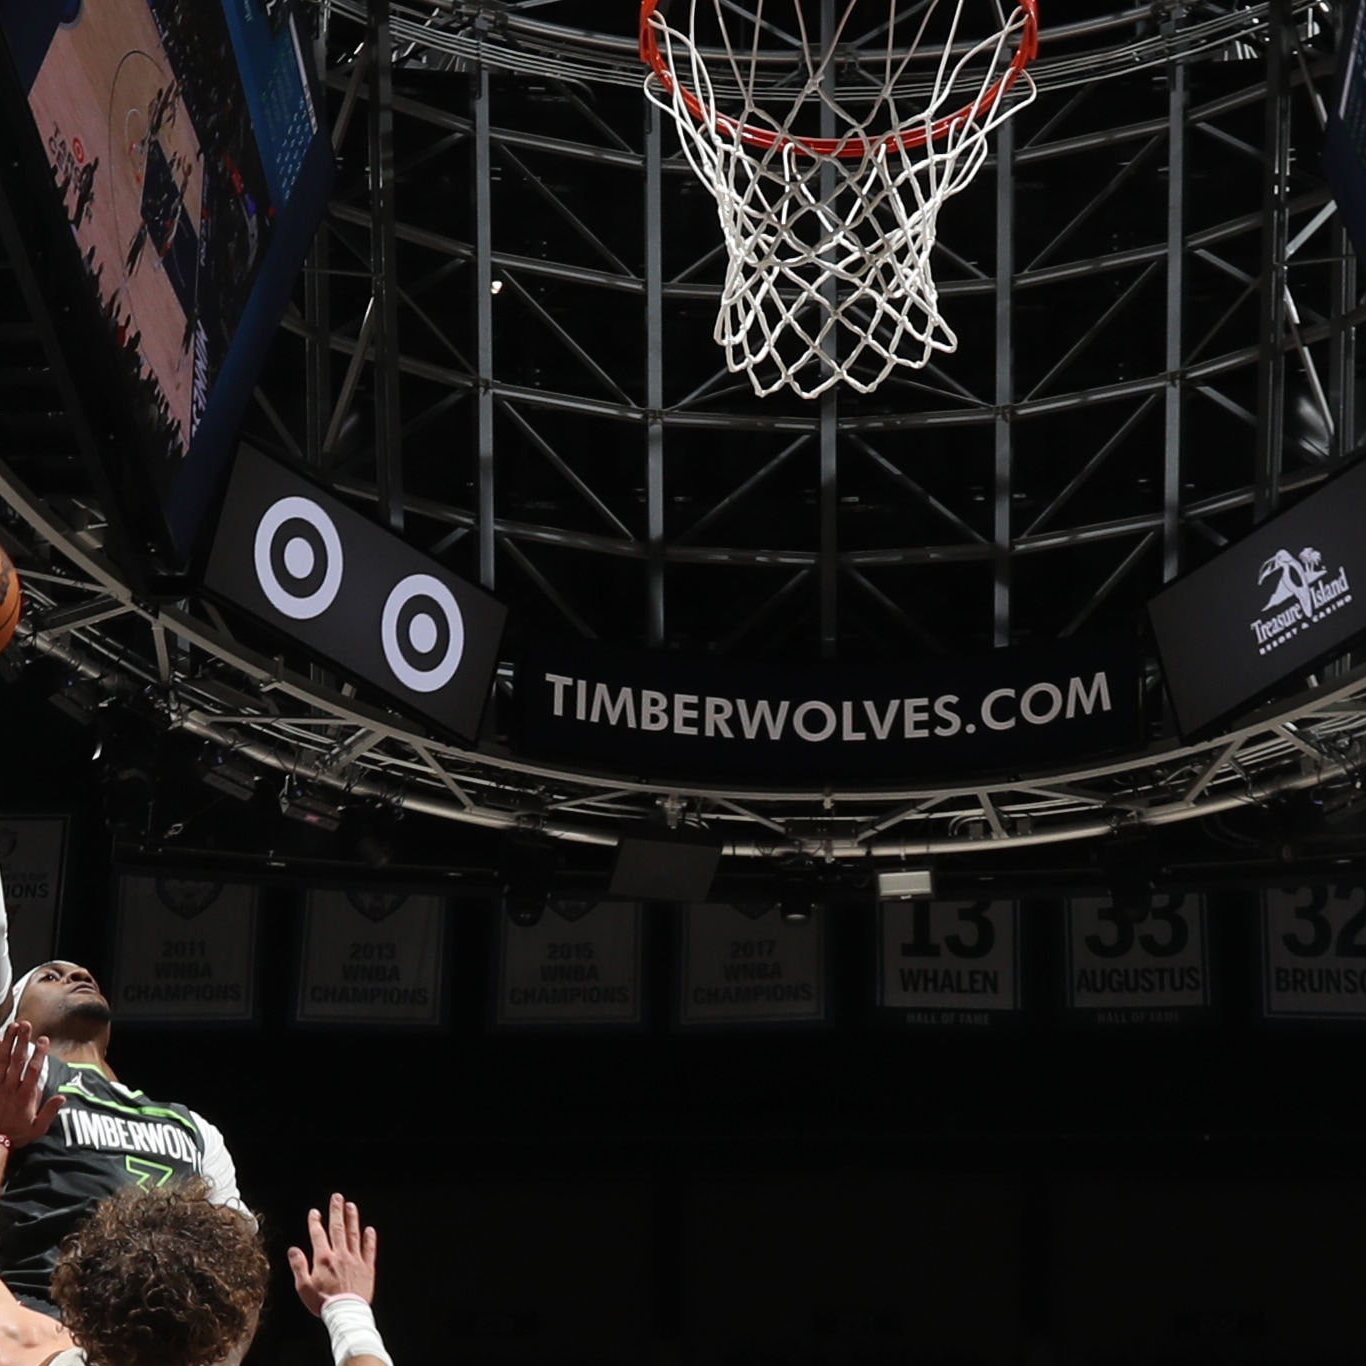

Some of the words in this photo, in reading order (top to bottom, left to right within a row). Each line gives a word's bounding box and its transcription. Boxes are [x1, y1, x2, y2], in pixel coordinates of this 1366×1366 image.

[1250, 603, 1303, 645] Treasure
[1310, 566, 1350, 610] Island
[544, 670, 1112, 743] TIMBERWOLVES.COM
[901, 900, 995, 958] 13
[1085, 897, 1189, 958] 33
[162, 940, 206, 957] 2011
[350, 942, 396, 960] 2013
[548, 942, 593, 960] 2015
[730, 940, 776, 958] 2017
[155, 962, 212, 979] WNBA
[342, 964, 400, 983] WNBA
[540, 964, 599, 983] WNBA
[723, 961, 782, 981] WNBA
[1077, 967, 1201, 993] AUGUSTUS
[124, 982, 242, 1001] CHAMPIONS
[899, 969, 998, 995] WHALEN
[310, 985, 428, 1005] CHAMPIONS
[510, 985, 629, 1005] CHAMPIONS
[692, 983, 813, 1005] CHAMPIONS
[58, 1108, 202, 1175] TIMBERWOLV
